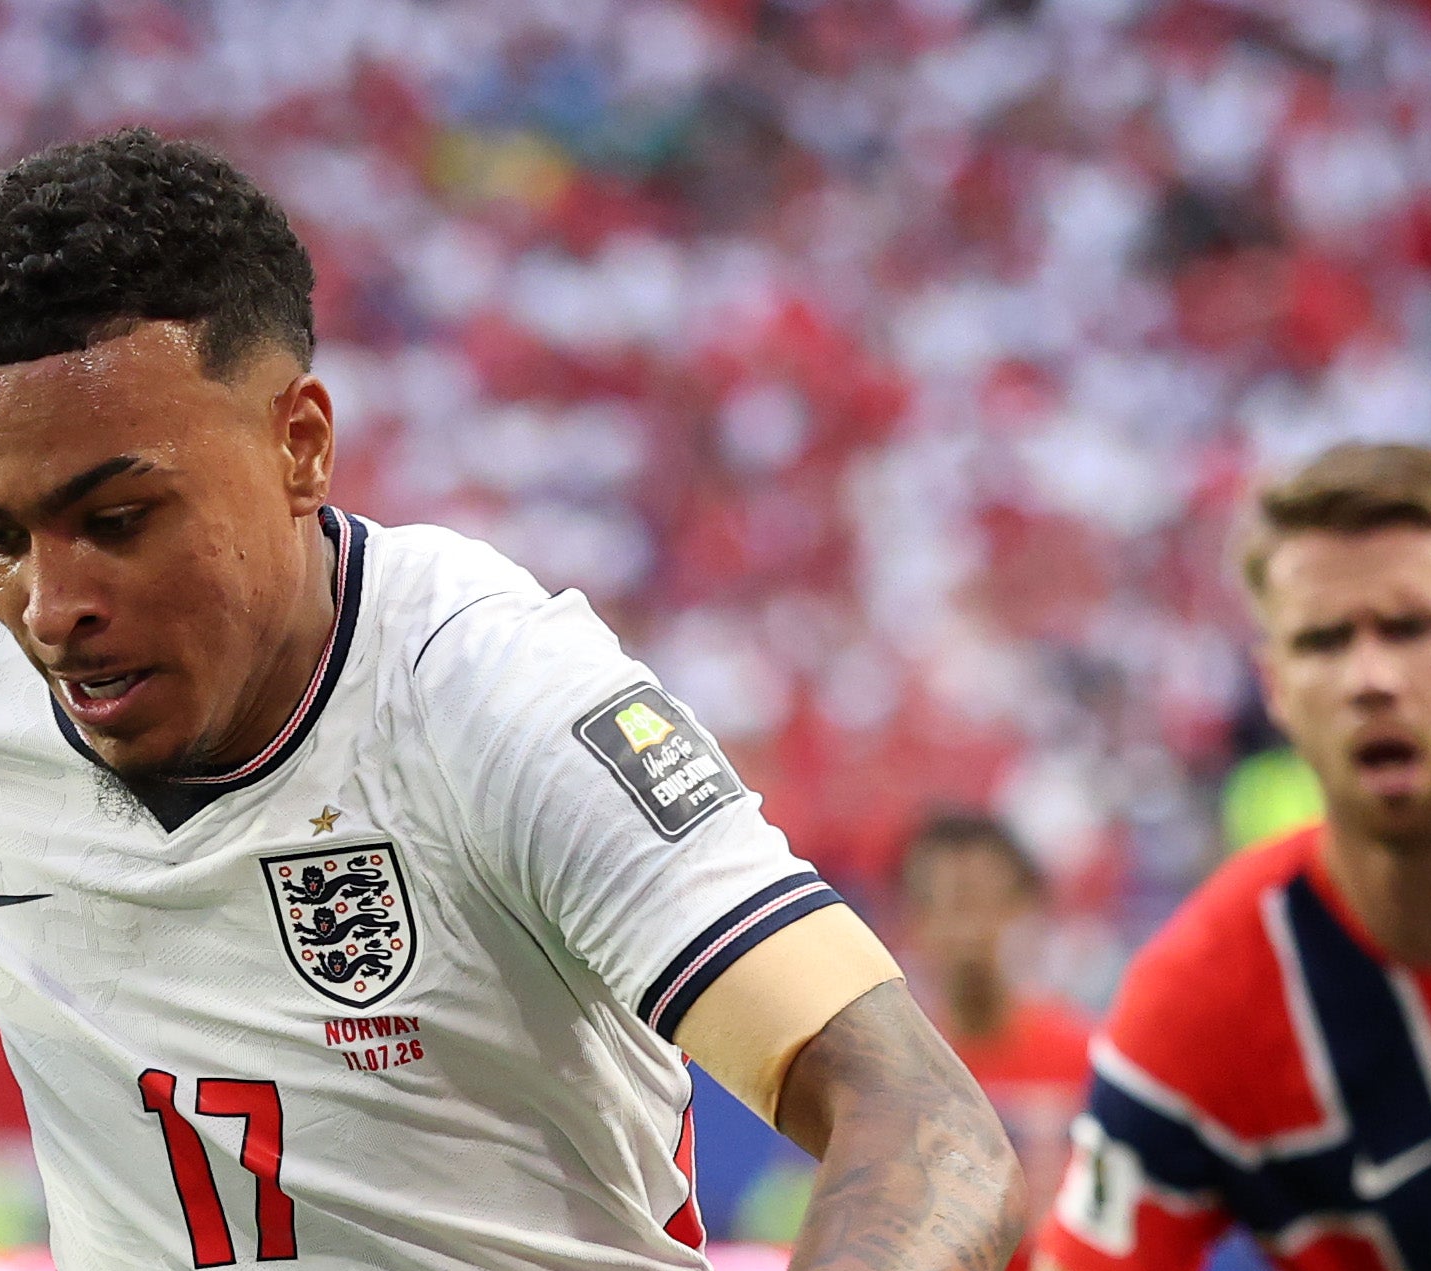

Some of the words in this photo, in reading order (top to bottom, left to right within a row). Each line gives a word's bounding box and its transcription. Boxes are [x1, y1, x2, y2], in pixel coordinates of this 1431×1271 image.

[687, 782, 719, 806] FIFA
[324, 1016, 421, 1047] NORWAY
[342, 1039, 425, 1072] 11.07.26
[137, 1067, 298, 1270] 17
